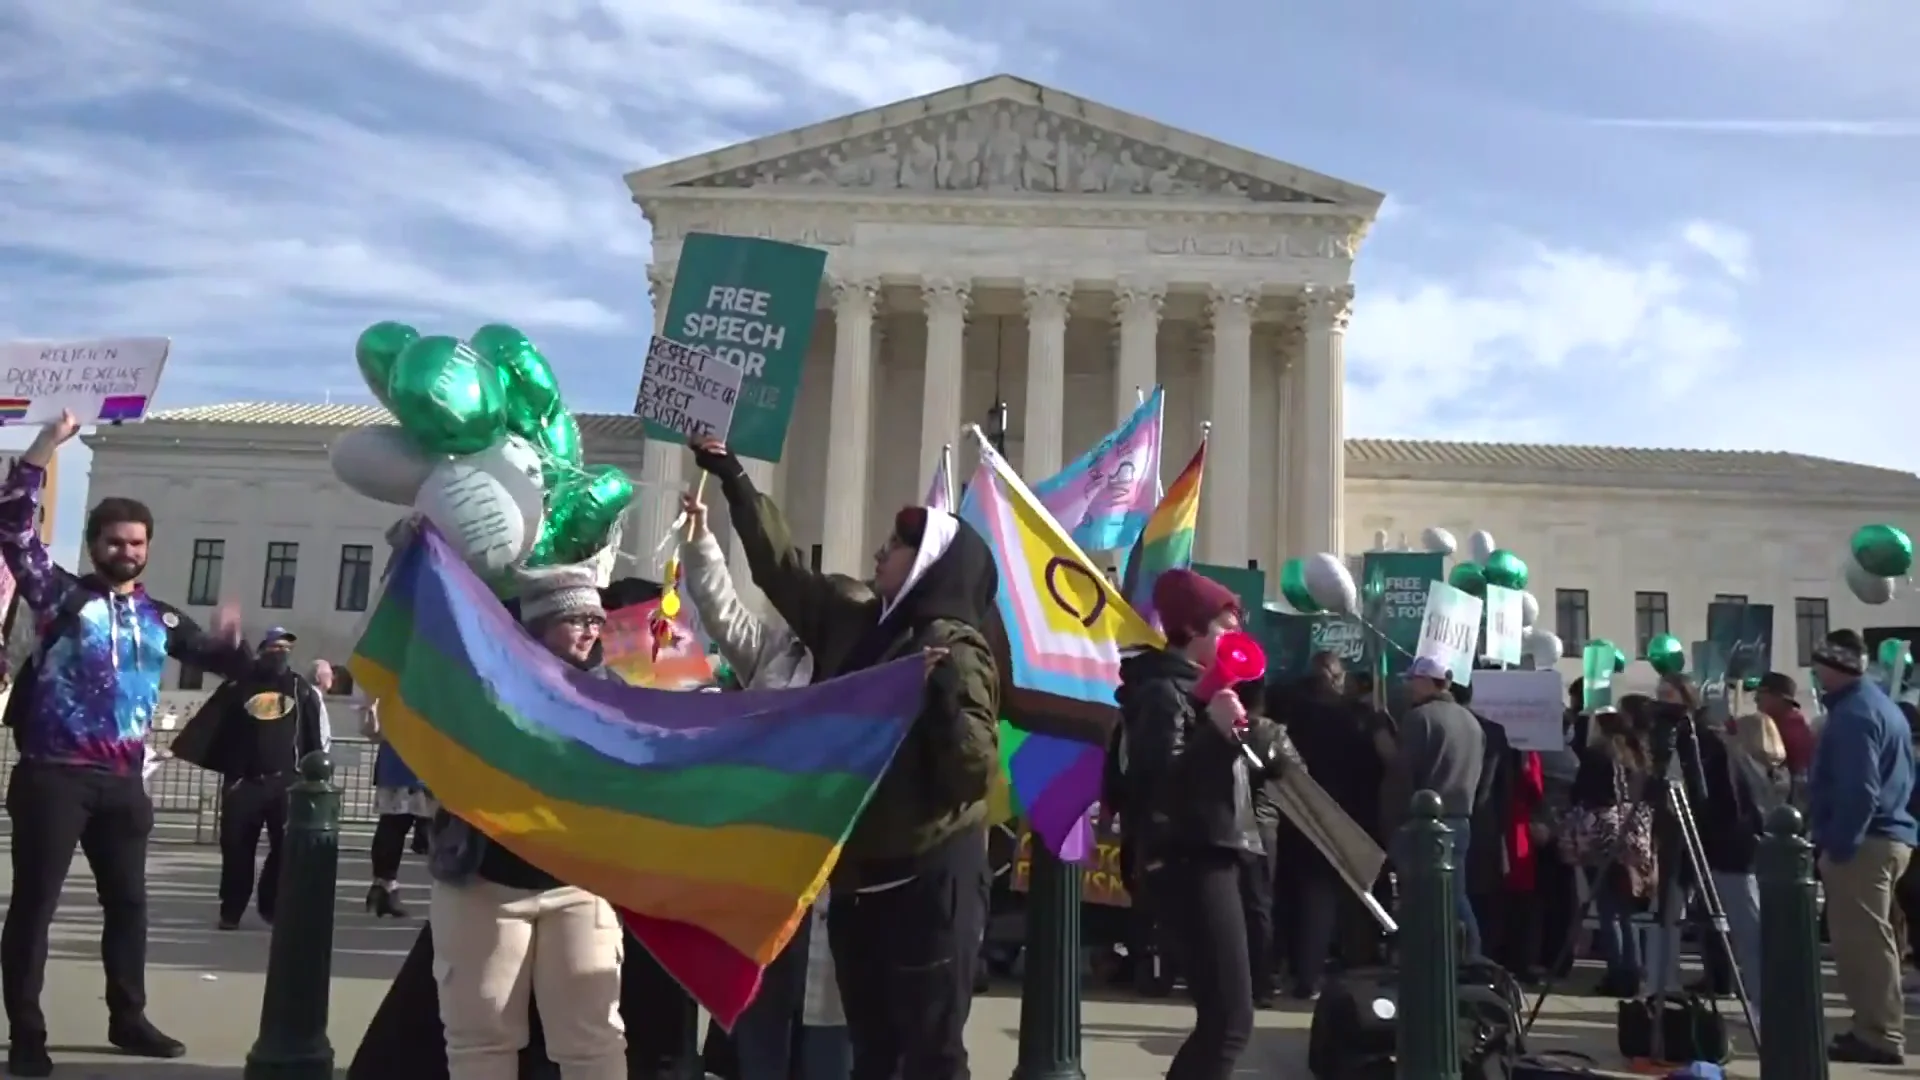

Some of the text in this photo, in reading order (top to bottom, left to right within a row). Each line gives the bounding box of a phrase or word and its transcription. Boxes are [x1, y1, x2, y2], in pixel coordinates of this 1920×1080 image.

[706, 285, 771, 316] FREE
[682, 312, 786, 350] SPEECH
[643, 356, 722, 400] EXISTENCE
[1386, 577, 1421, 590] FREE
